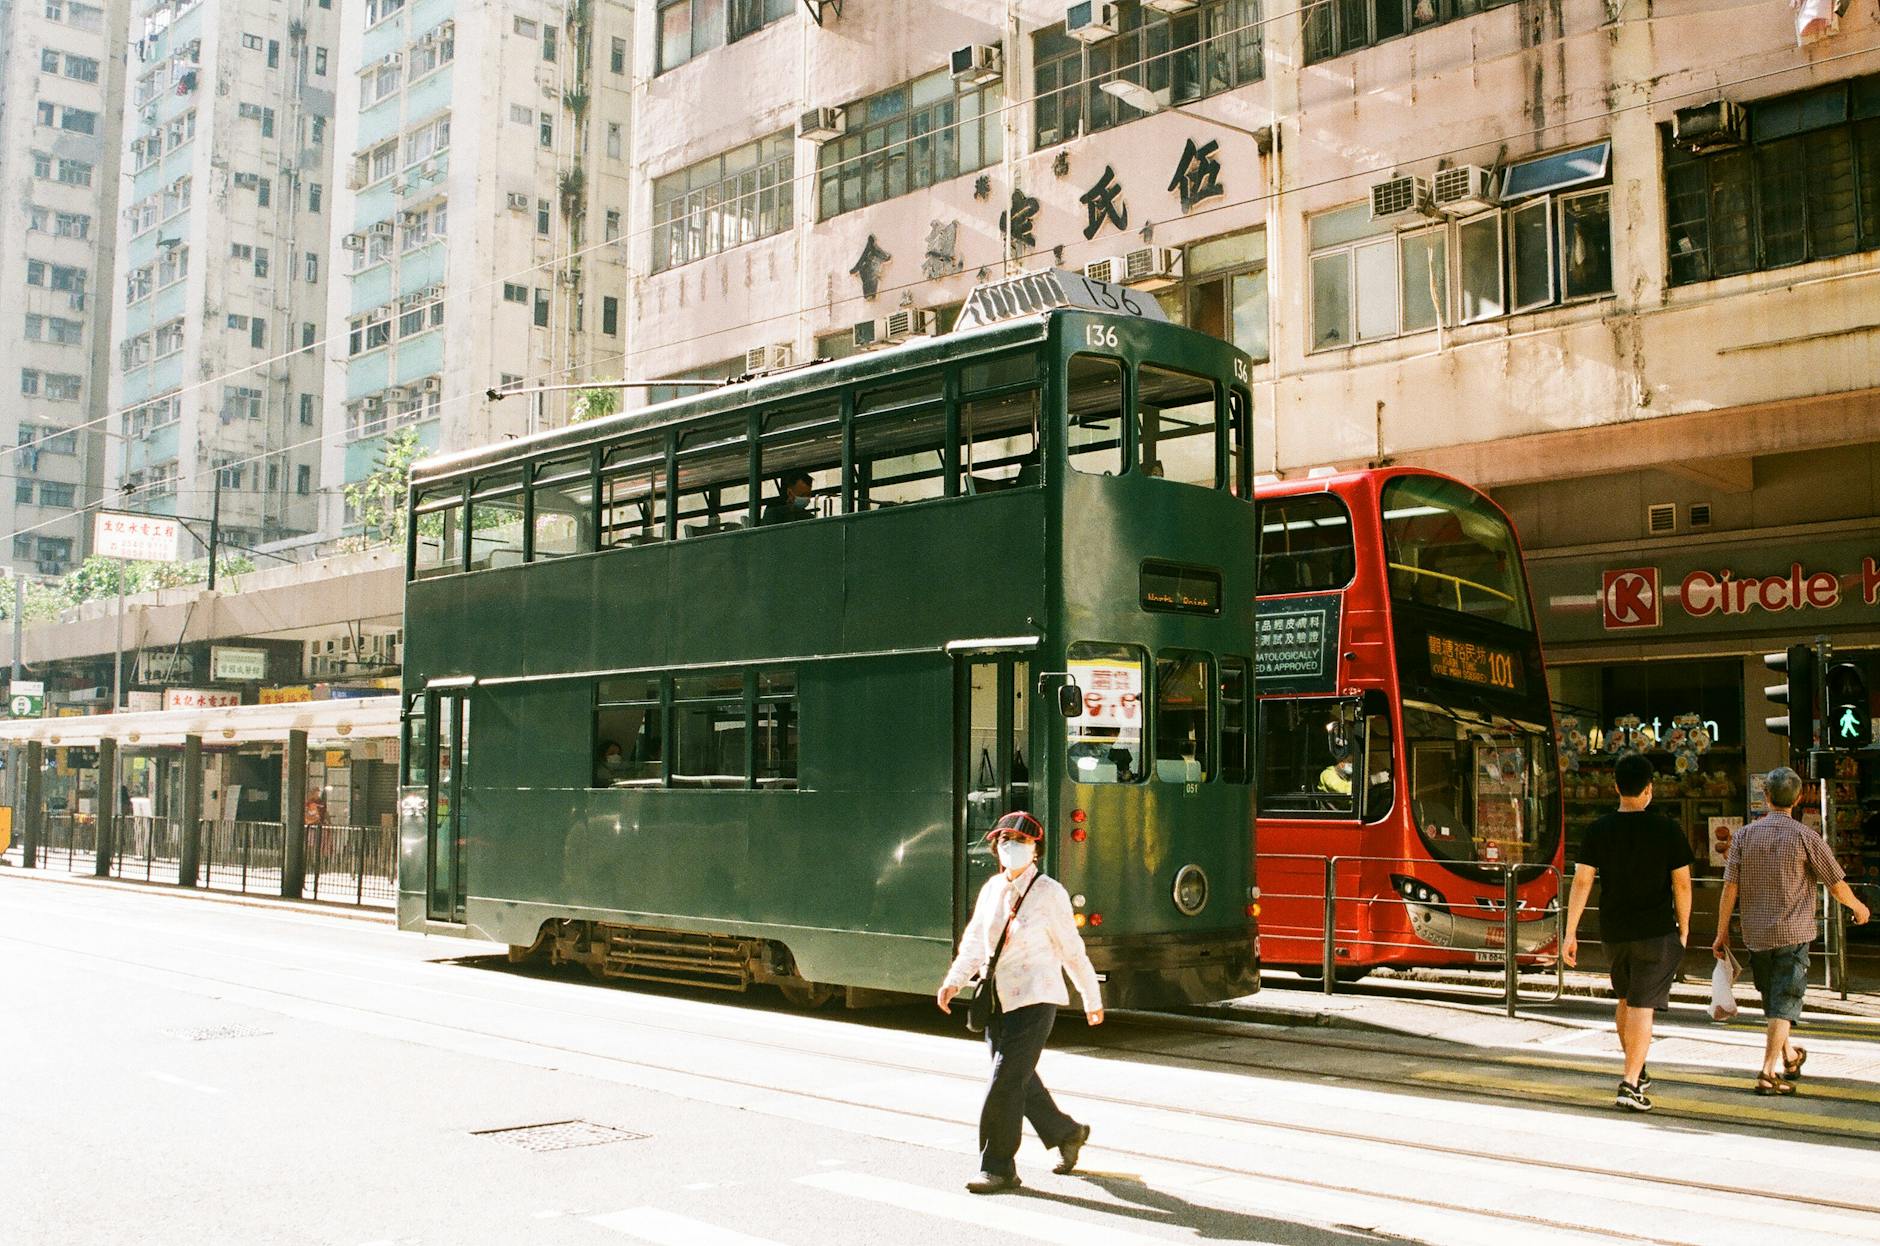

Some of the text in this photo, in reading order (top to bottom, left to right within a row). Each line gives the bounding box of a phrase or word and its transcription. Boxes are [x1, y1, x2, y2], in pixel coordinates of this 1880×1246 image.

[1081, 277, 1144, 317] 136
[1086, 324, 1119, 348] 136
[1233, 356, 1248, 384] 136
[1614, 575, 1655, 620] K
[1680, 562, 1839, 617] Circle
[1256, 631, 1319, 647] 測試及驗證
[1266, 663, 1272, 672] &
[1273, 661, 1318, 672] APPROVED
[1488, 652, 1515, 689] 101
[1186, 783, 1199, 795] 051
